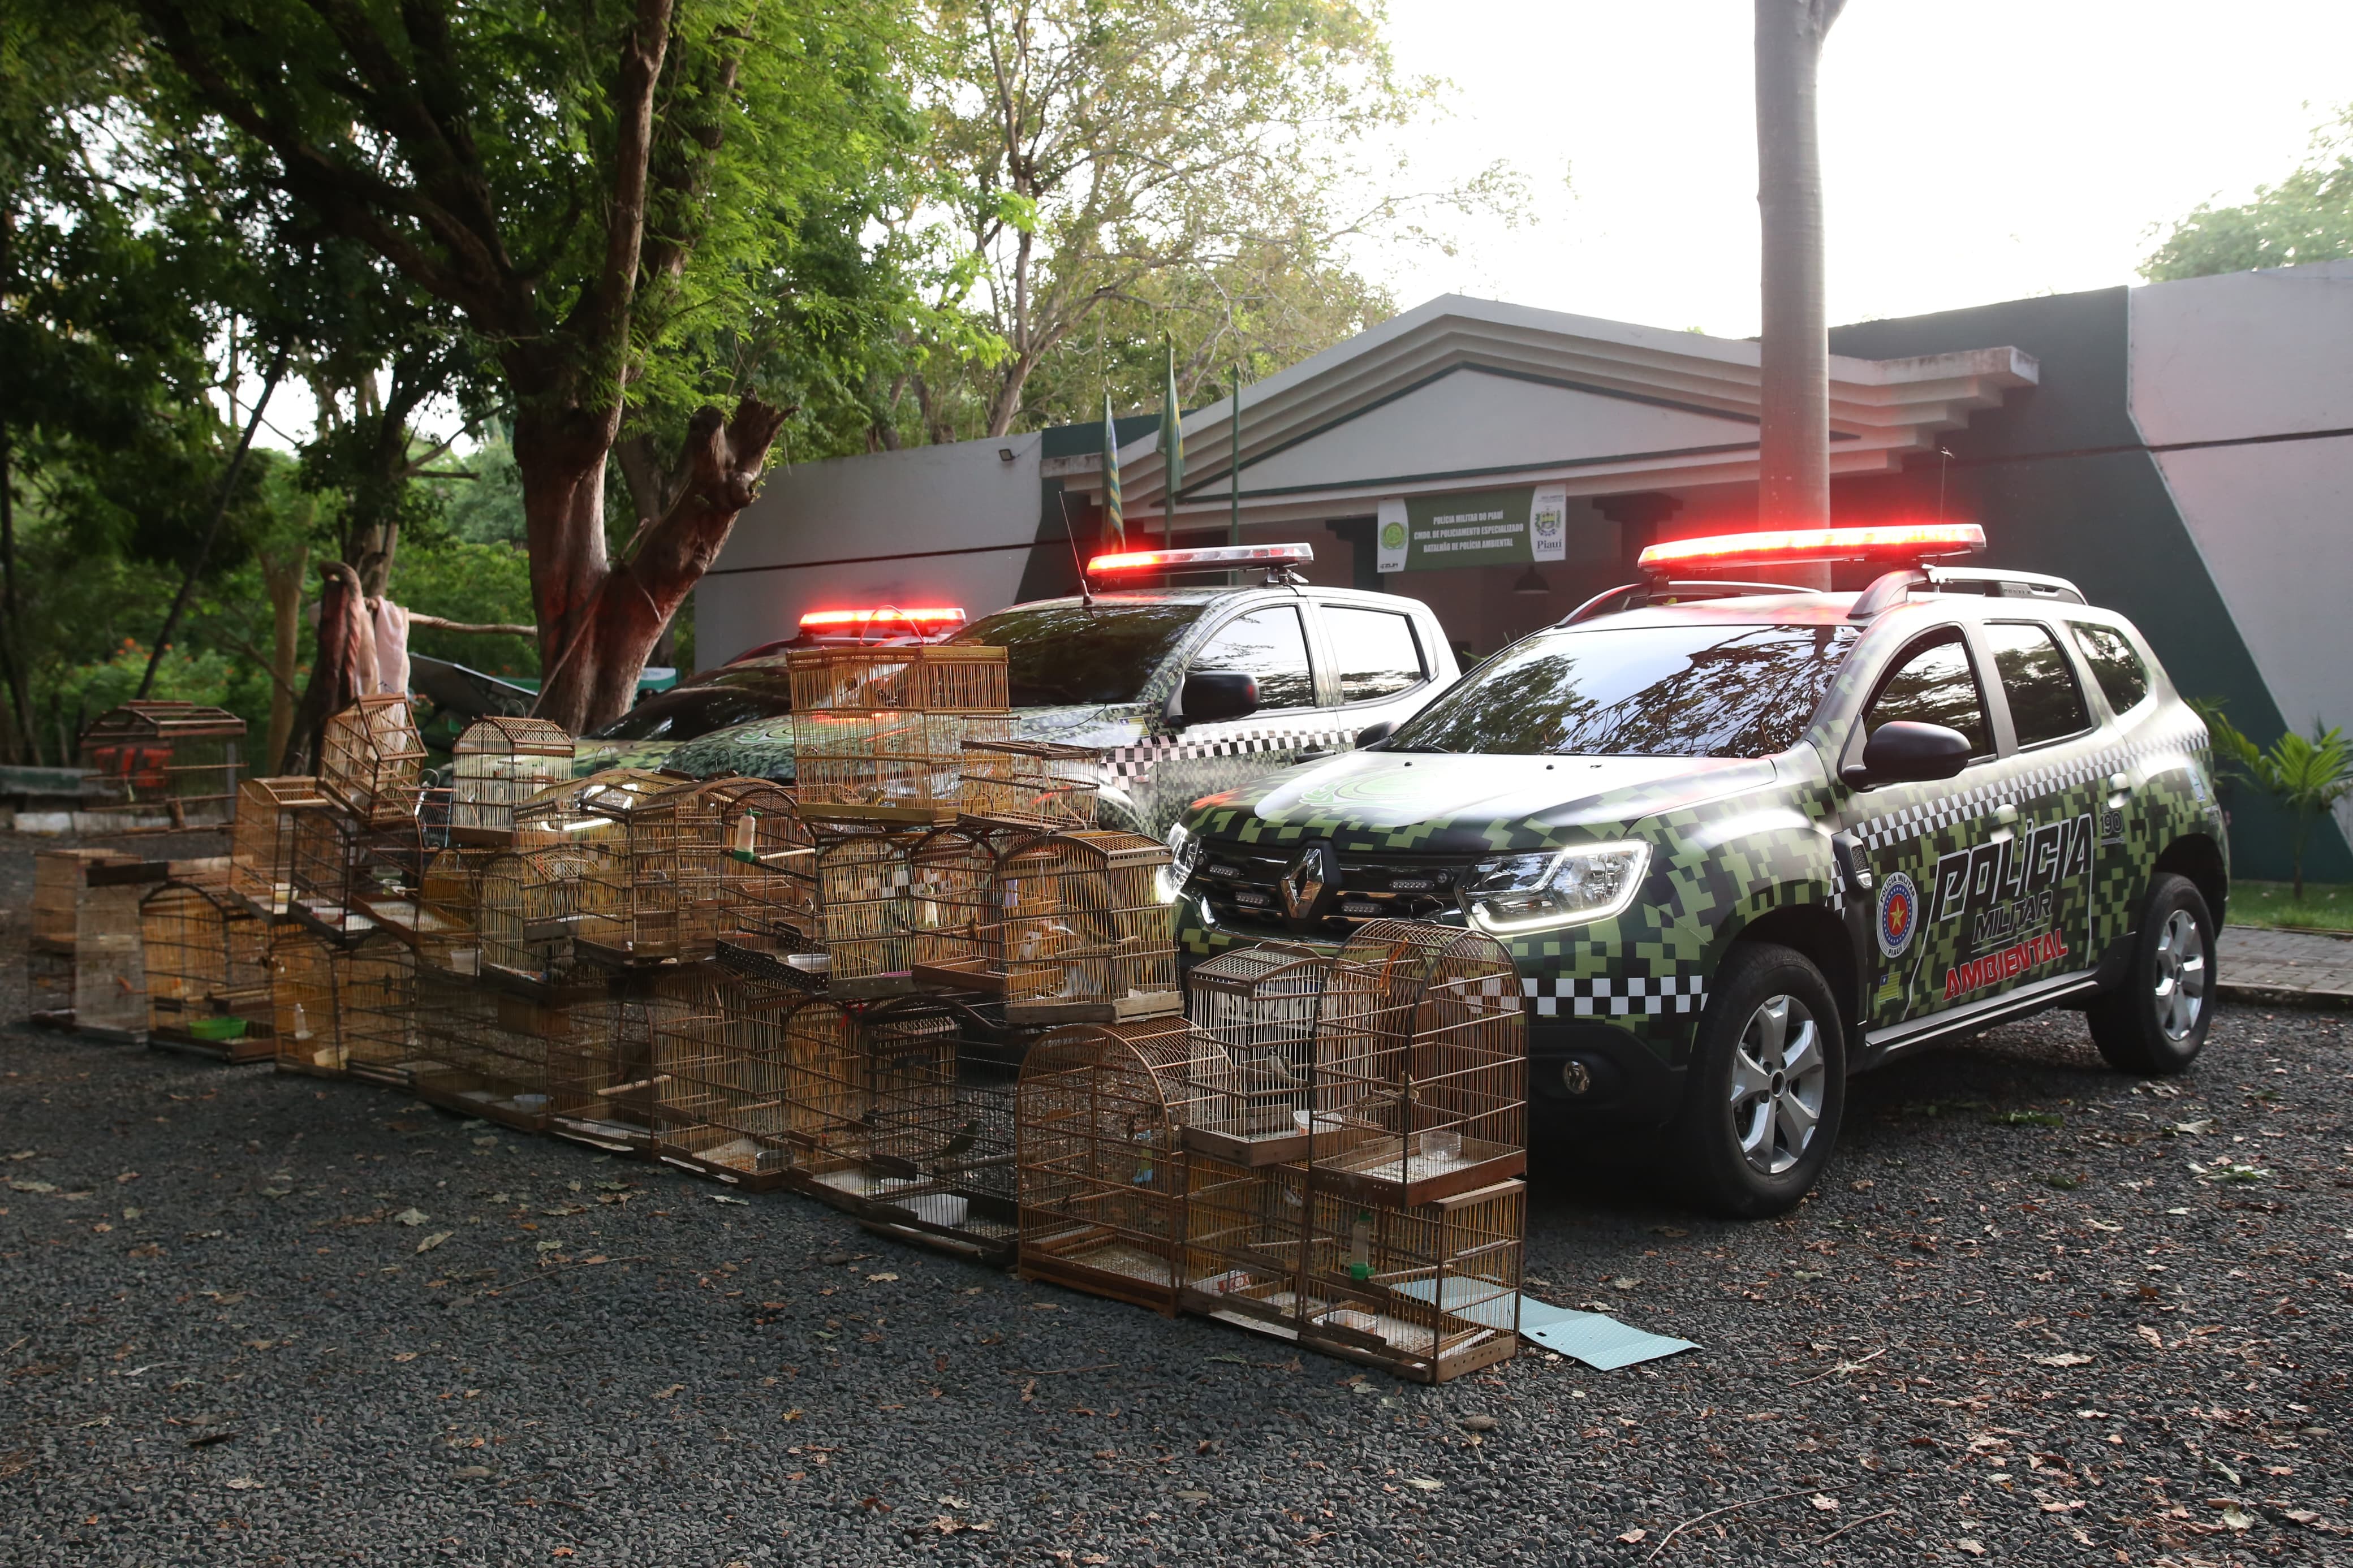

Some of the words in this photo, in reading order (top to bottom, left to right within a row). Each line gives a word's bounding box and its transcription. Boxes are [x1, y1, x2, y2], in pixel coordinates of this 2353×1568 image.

[1433, 515, 1455, 525] POLÍCIA
[1455, 513, 1478, 523] MILITAR
[1479, 512, 1486, 521] DO
[1488, 509, 1503, 520] PIAUÍ
[1432, 530, 1440, 538] DE
[1441, 526, 1480, 538] POLICIAMENTO
[1481, 523, 1524, 535] ESPECIALIZADO
[1424, 542, 1450, 553] BATALHÃO
[1451, 542, 1459, 551] DE
[1459, 540, 1481, 550] POLÍCIA
[1482, 538, 1513, 548] AMBIENTAL
[1537, 539, 1562, 549] Piauí
[2099, 811, 2123, 836] 190
[1930, 813, 2092, 922] POLÍCIA
[1880, 876, 1897, 903] POLÍCIA
[1898, 874, 1915, 898] MILITAR
[1971, 889, 2053, 945] MILITAR
[1887, 944, 1902, 956] PIAUÍ
[1942, 928, 2068, 1003] AMBIENTAL
